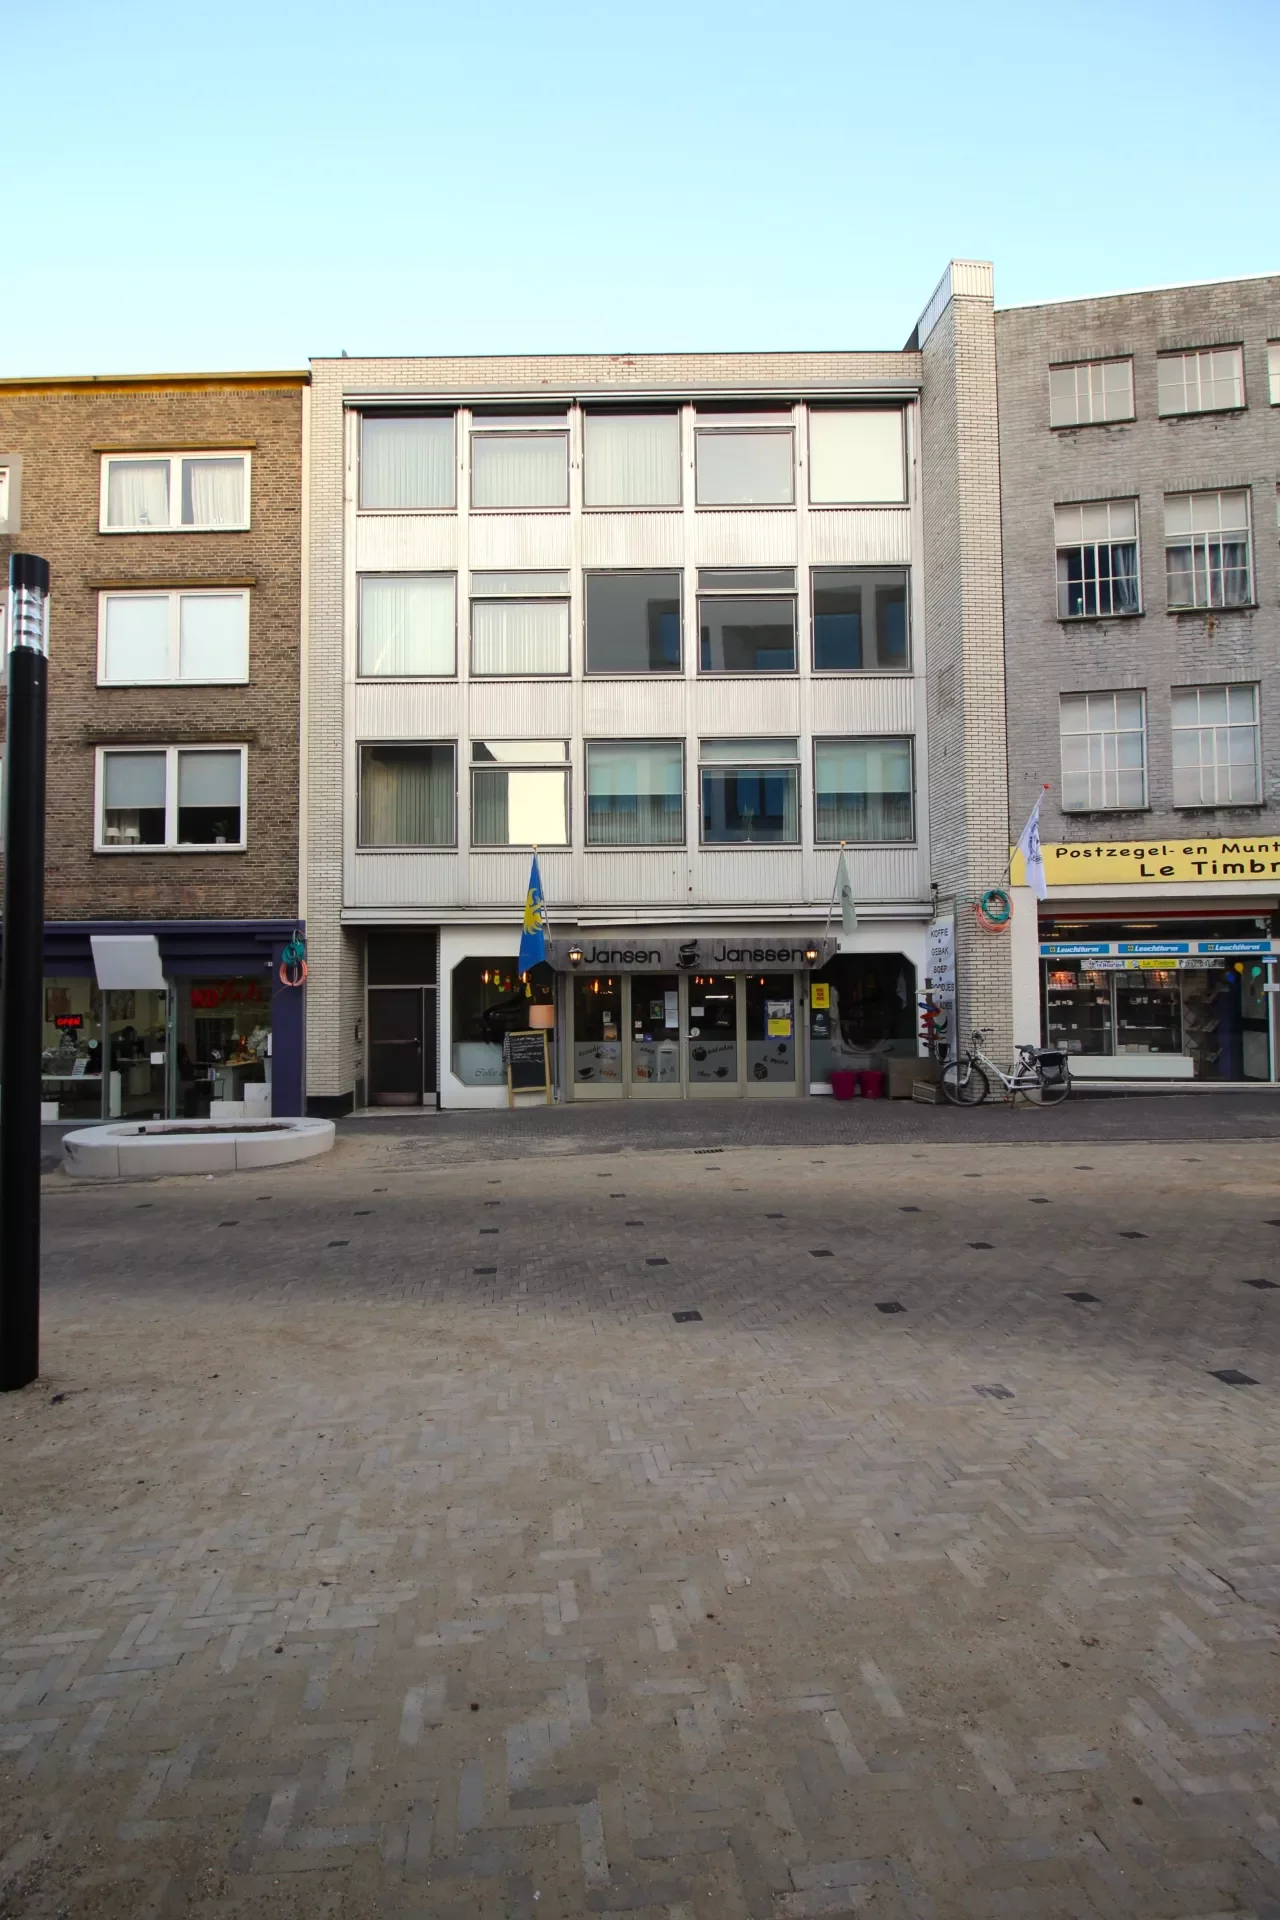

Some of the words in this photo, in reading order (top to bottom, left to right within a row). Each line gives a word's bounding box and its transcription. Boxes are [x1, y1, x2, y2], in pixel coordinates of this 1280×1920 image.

[1055, 844, 1175, 860] Postzegel-
[1182, 845, 1208, 856] en
[1140, 863, 1176, 877] Le
[930, 928, 949, 938] KOFFIE
[931, 946, 949, 956] GEBAK
[1056, 945, 1100, 953] Leuchtturm
[1134, 944, 1179, 952] Leuchtturm
[584, 946, 661, 964] Jansen
[714, 945, 804, 963] Janssen
[56, 1017, 81, 1027] OPEN
